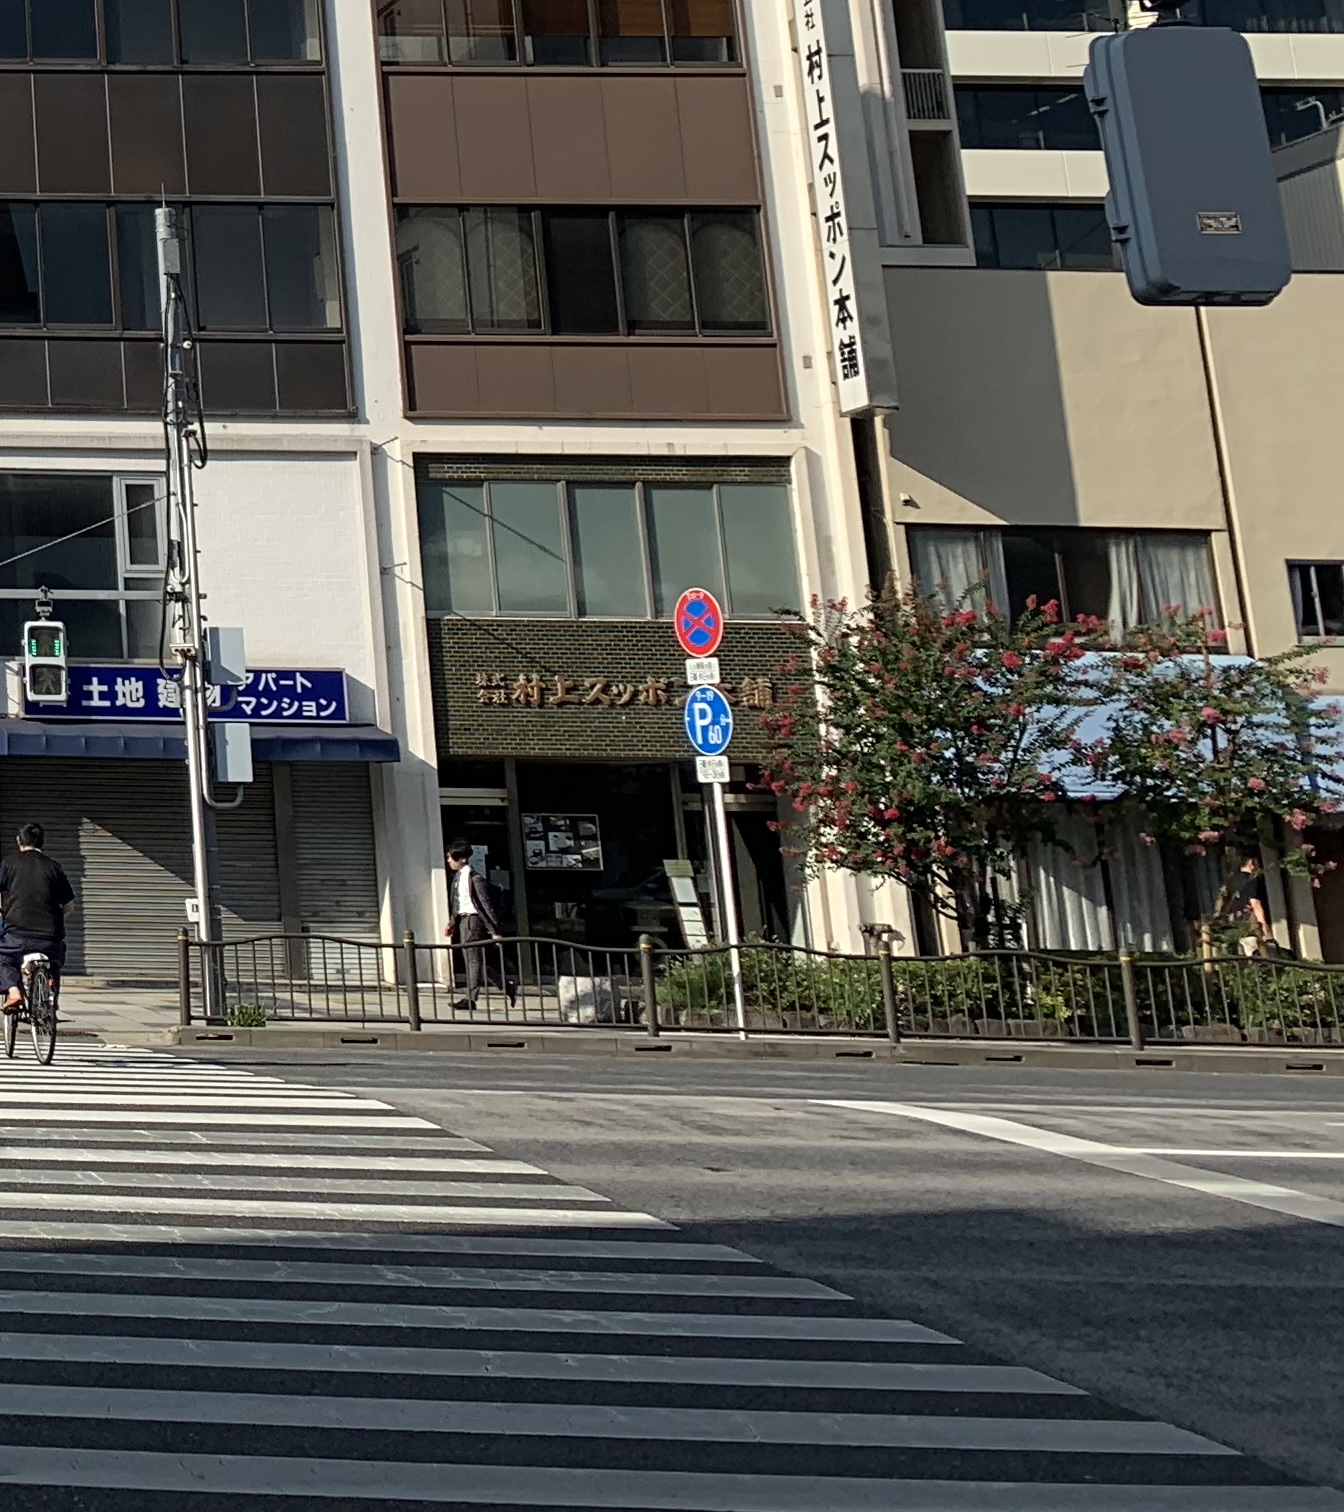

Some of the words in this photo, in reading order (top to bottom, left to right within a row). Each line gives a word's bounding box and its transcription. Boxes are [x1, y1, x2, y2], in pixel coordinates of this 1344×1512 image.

[805, 39, 861, 381] 村上スッポン本舗
[81, 676, 146, 708] 土地
[236, 695, 337, 718] マンション
